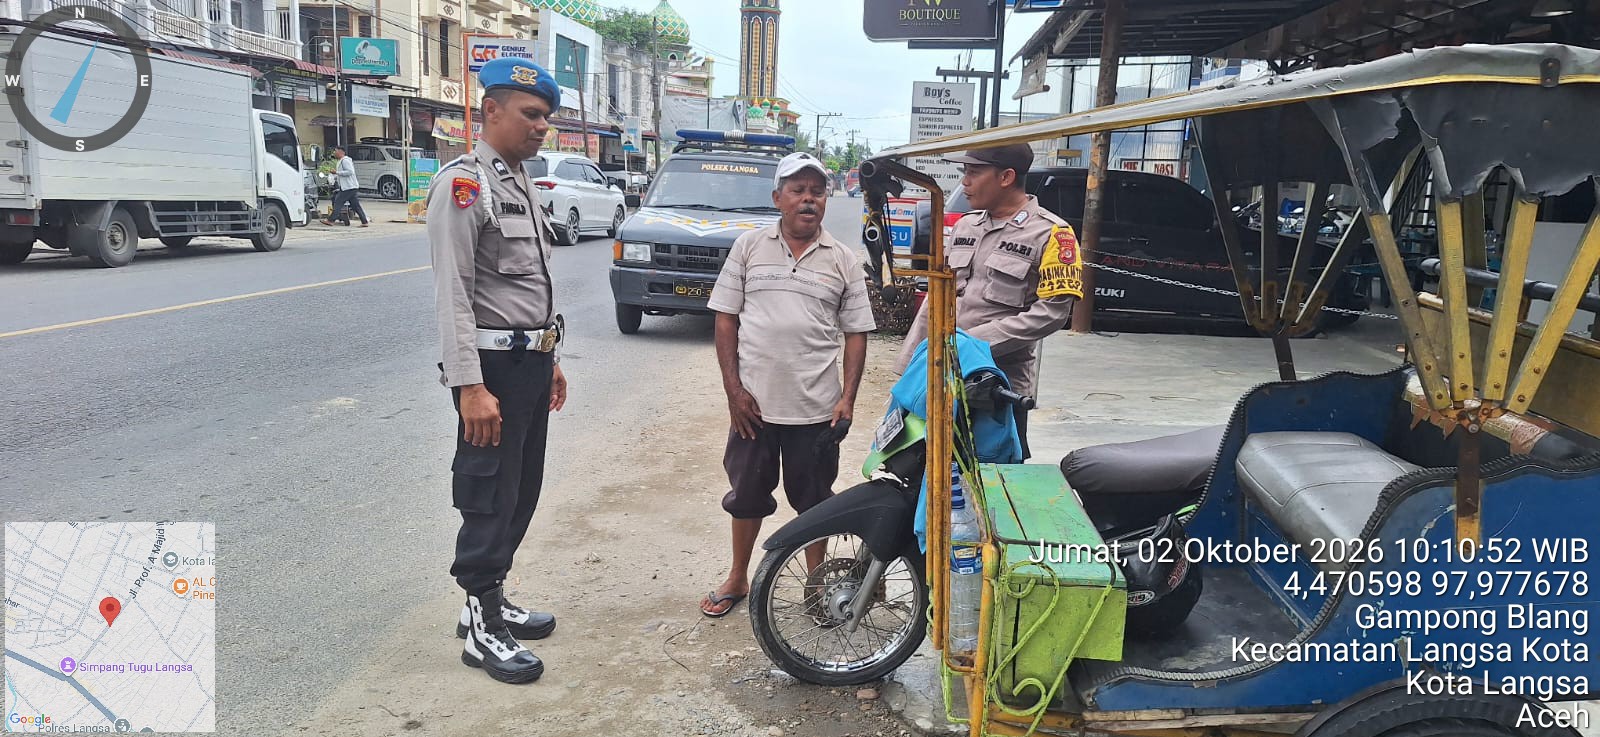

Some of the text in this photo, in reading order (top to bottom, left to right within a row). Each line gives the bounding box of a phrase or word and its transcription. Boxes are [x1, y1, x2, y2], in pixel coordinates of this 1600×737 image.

[899, 8, 960, 21] BOUTIQUE
[924, 87, 951, 98] Boy's
[701, 163, 759, 174] POLSEK LANGSA
[1154, 163, 1174, 176] NASI
[999, 240, 1033, 257] POLRI
[1040, 264, 1081, 281] ABINKAMTI
[1094, 287, 1125, 298] ZUKI
